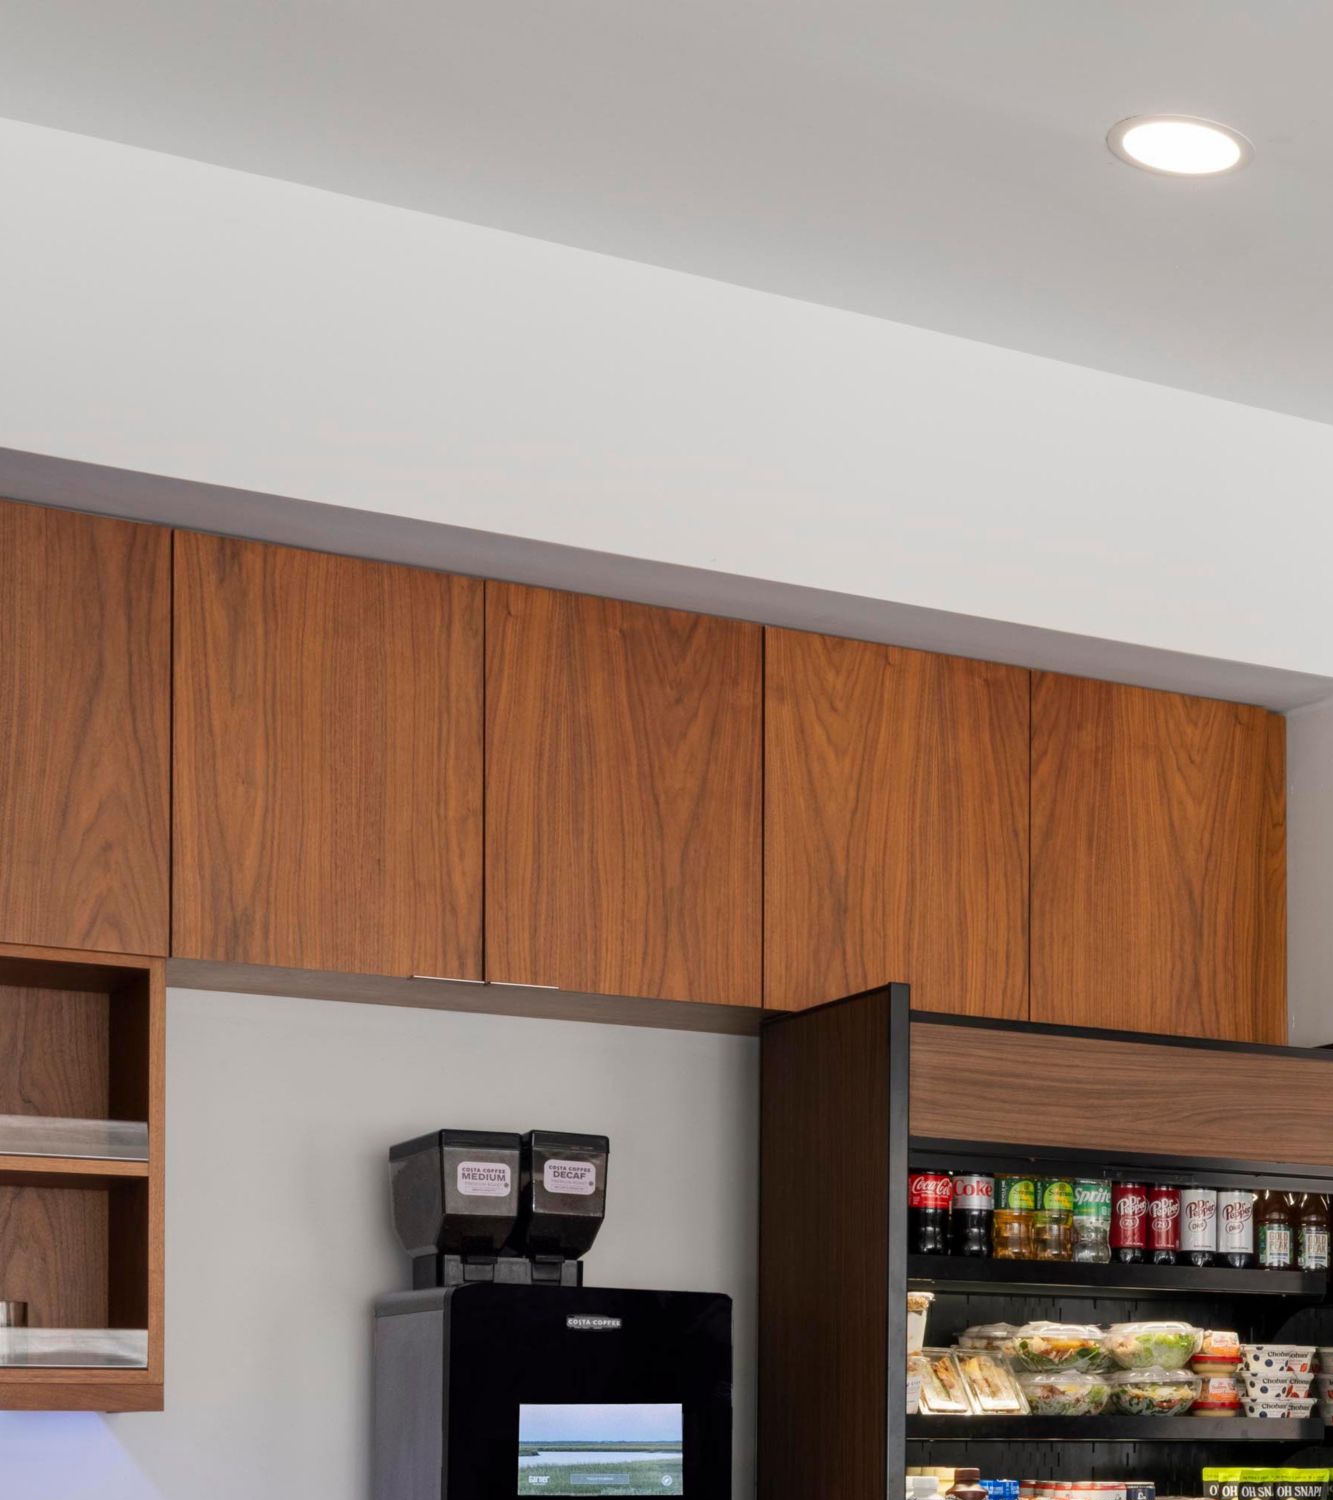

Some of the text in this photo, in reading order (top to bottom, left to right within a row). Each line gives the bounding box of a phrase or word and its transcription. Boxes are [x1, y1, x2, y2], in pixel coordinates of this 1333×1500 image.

[462, 1172, 506, 1182] MEDIUM
[553, 1171, 586, 1180] DECAF
[953, 1179, 993, 1198] Coke
[1074, 1187, 1111, 1204] Sprite
[1242, 1486, 1256, 1497] OH
[1277, 1486, 1292, 1497] OH
[1294, 1485, 1322, 1497] SNAP!
